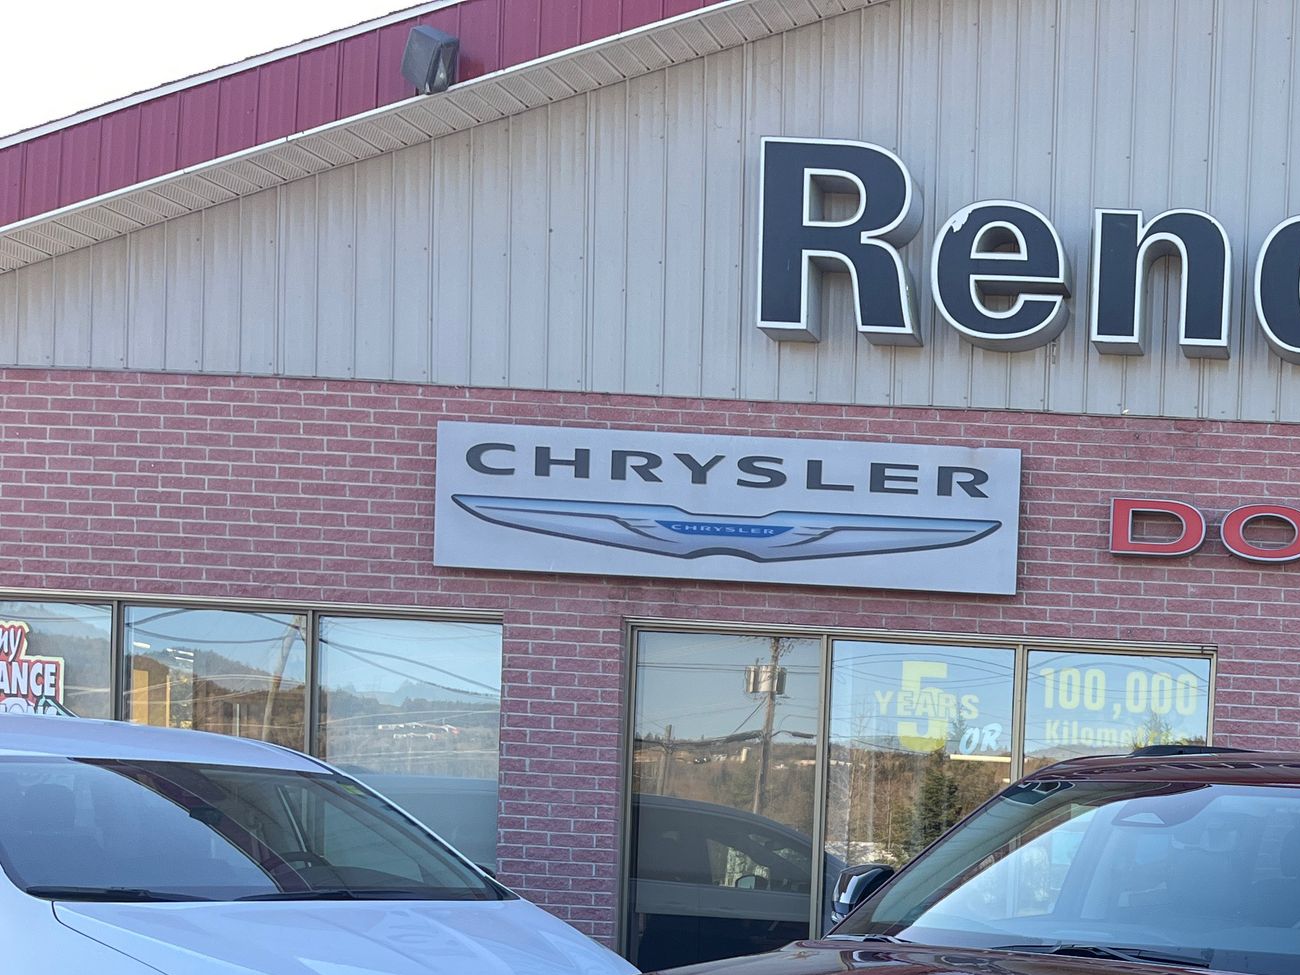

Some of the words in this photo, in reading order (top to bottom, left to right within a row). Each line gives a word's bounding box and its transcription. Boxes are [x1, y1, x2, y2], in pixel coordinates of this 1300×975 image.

[466, 442, 989, 498] CHRYSLER
[671, 524, 774, 535] CHRYSLER
[874, 690, 980, 719] YEARS
[897, 660, 948, 752] 5
[1040, 667, 1197, 721] 100,000
[959, 723, 1002, 756] OR
